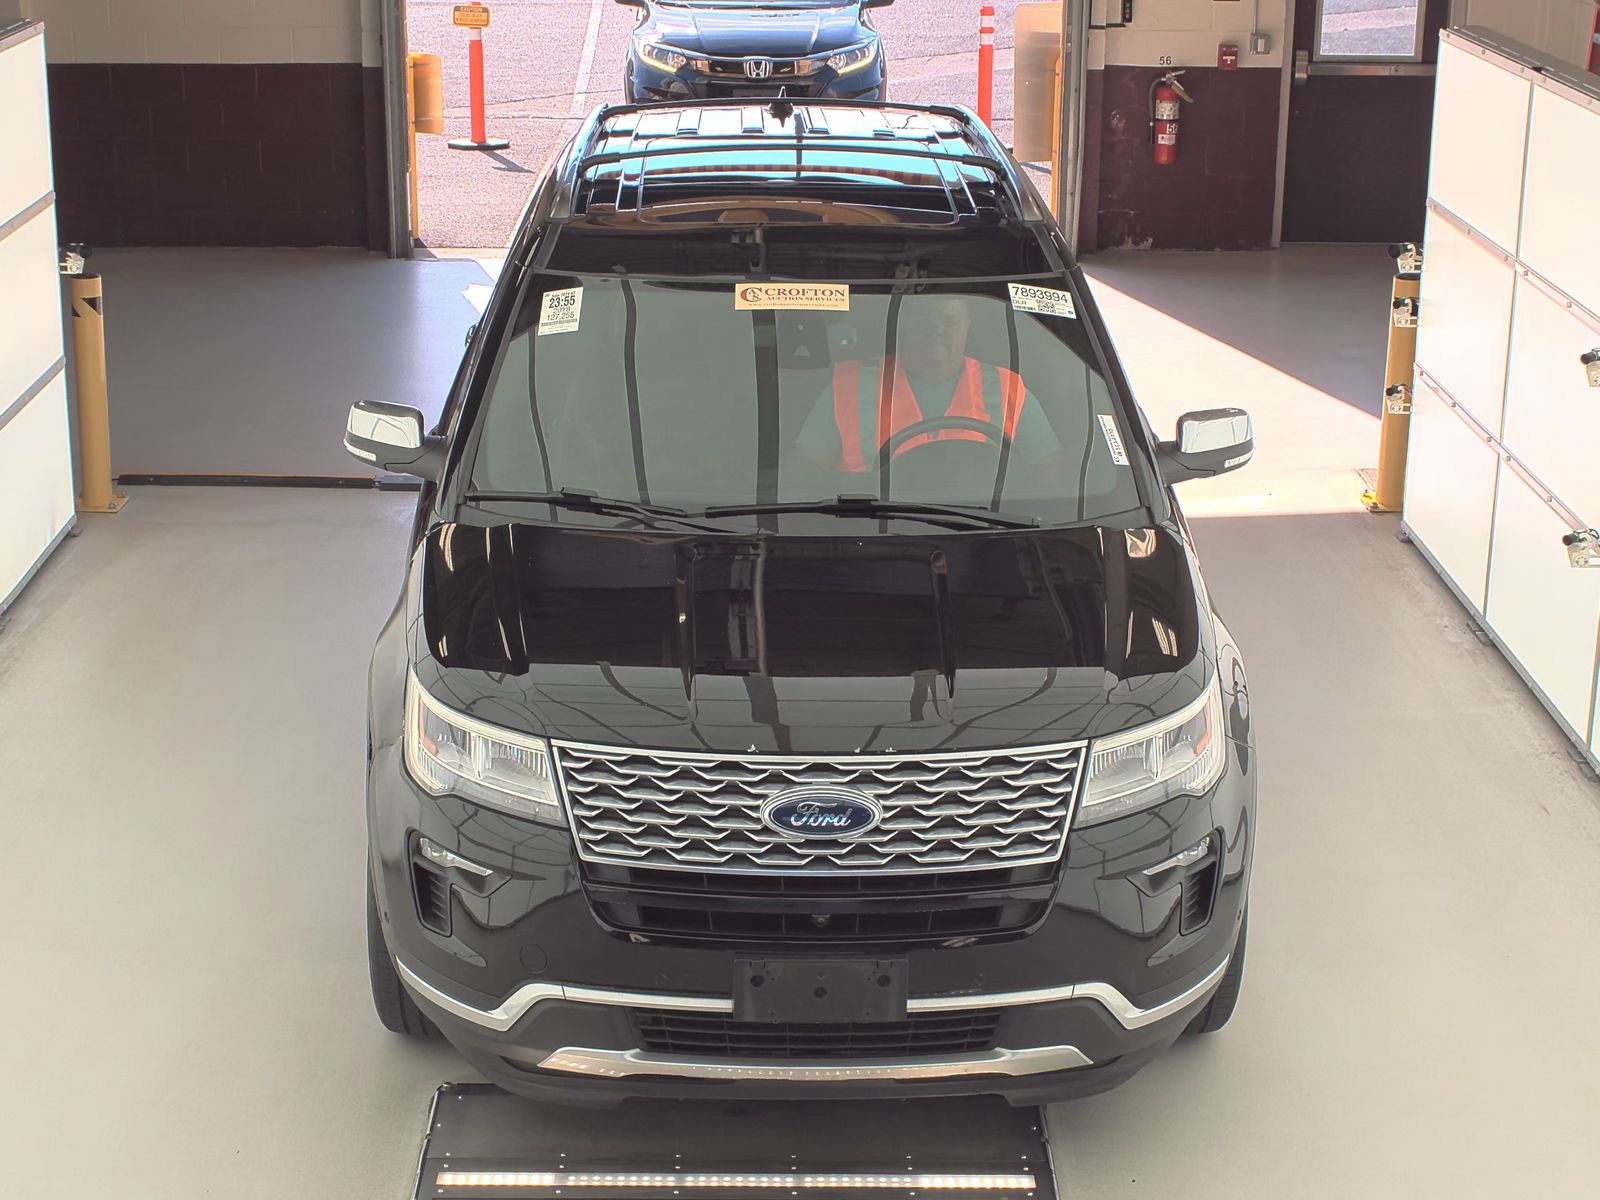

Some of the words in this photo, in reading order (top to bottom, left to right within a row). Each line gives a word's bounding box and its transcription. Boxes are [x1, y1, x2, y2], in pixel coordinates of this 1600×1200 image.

[1159, 56, 1172, 65] 56
[765, 288, 845, 297] CROFTON
[1011, 286, 1068, 303] 7893994
[548, 295, 576, 308] 23:55
[552, 306, 571, 314] 2018
[790, 801, 853, 826] Ford
